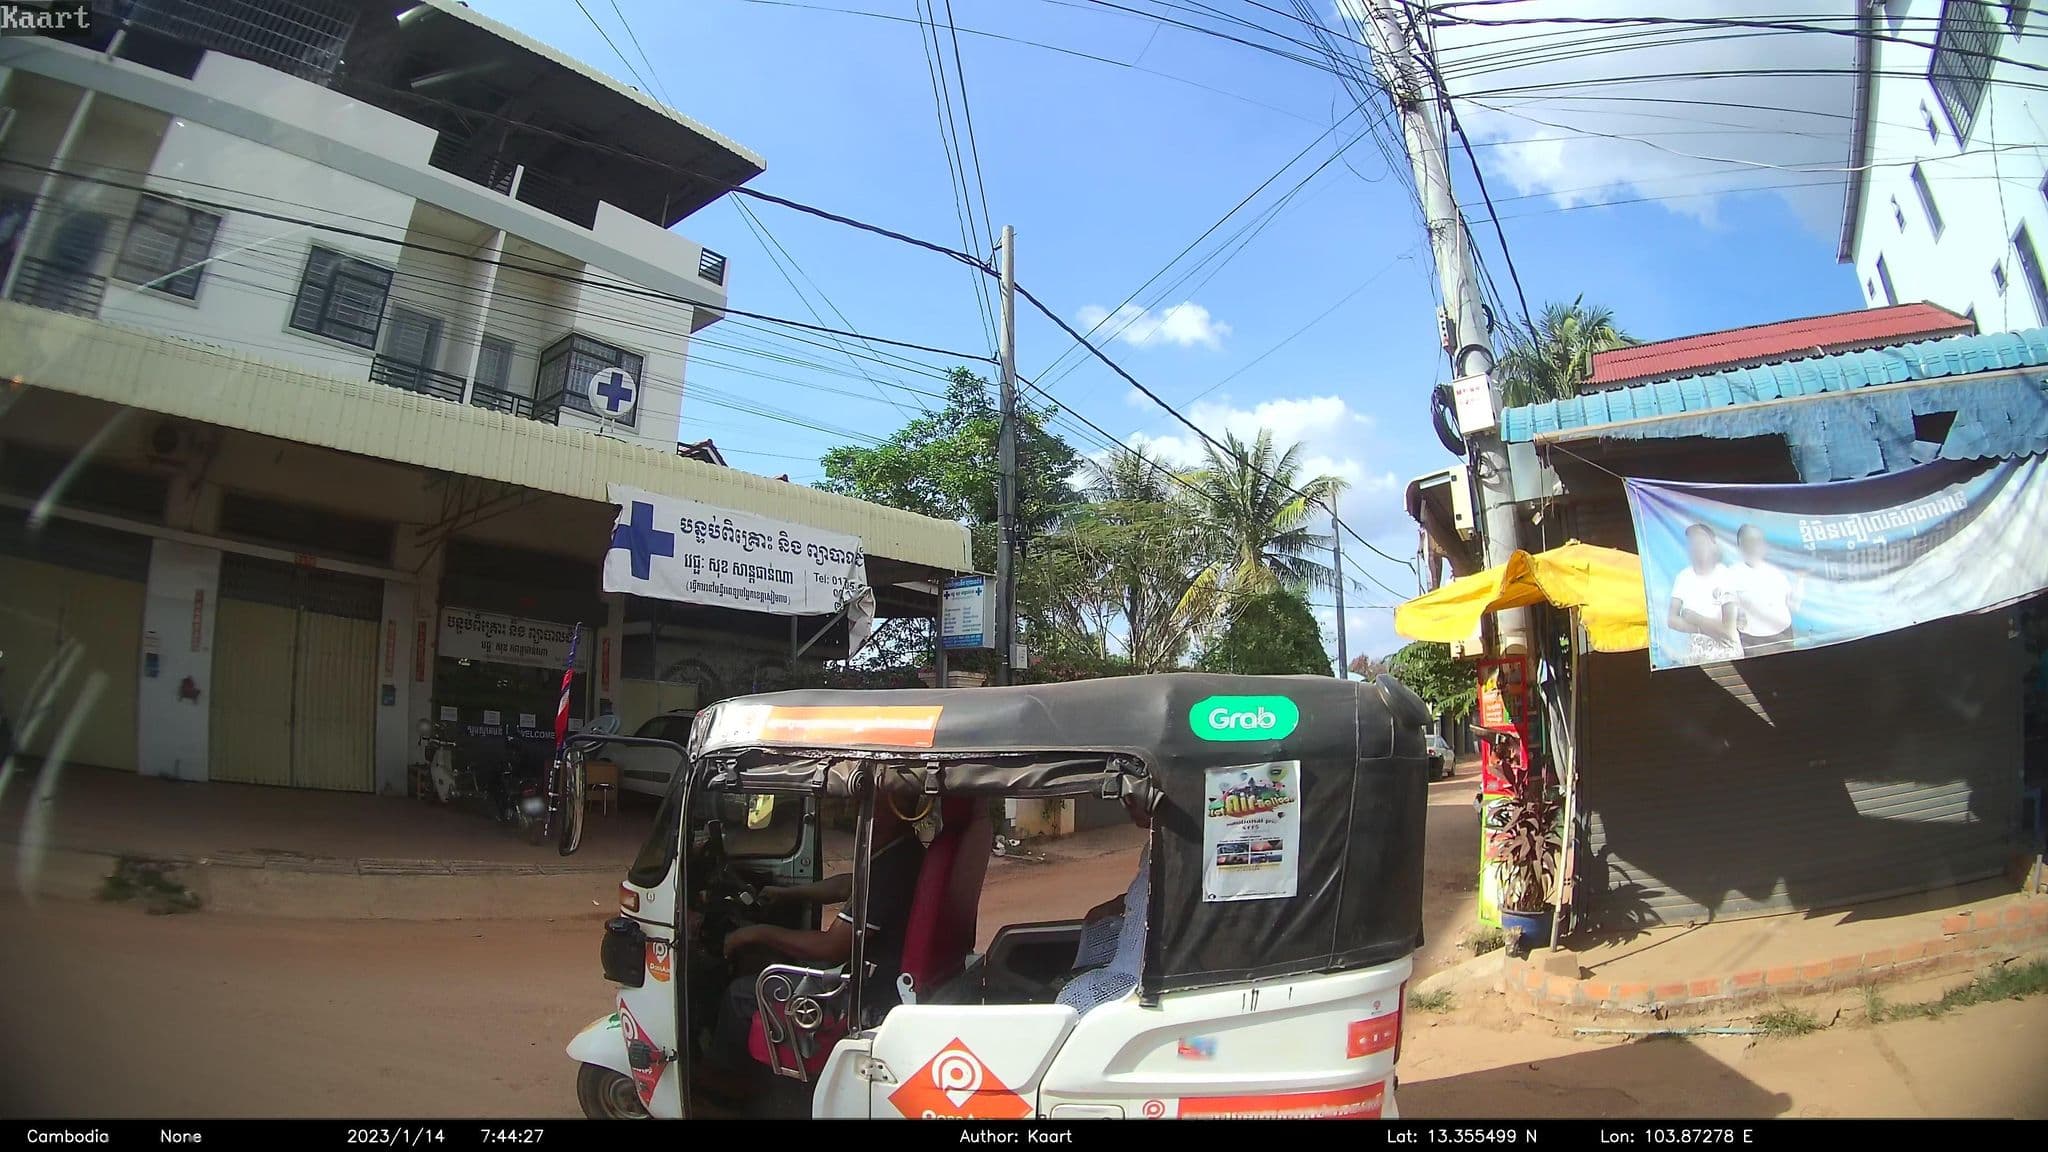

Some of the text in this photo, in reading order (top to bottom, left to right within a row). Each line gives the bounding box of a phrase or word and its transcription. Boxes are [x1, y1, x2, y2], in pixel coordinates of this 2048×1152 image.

[680, 515, 773, 552] បន្ទប់ពិគ្រោះ
[778, 530, 803, 555] និង
[1208, 706, 1276, 730] Grab
